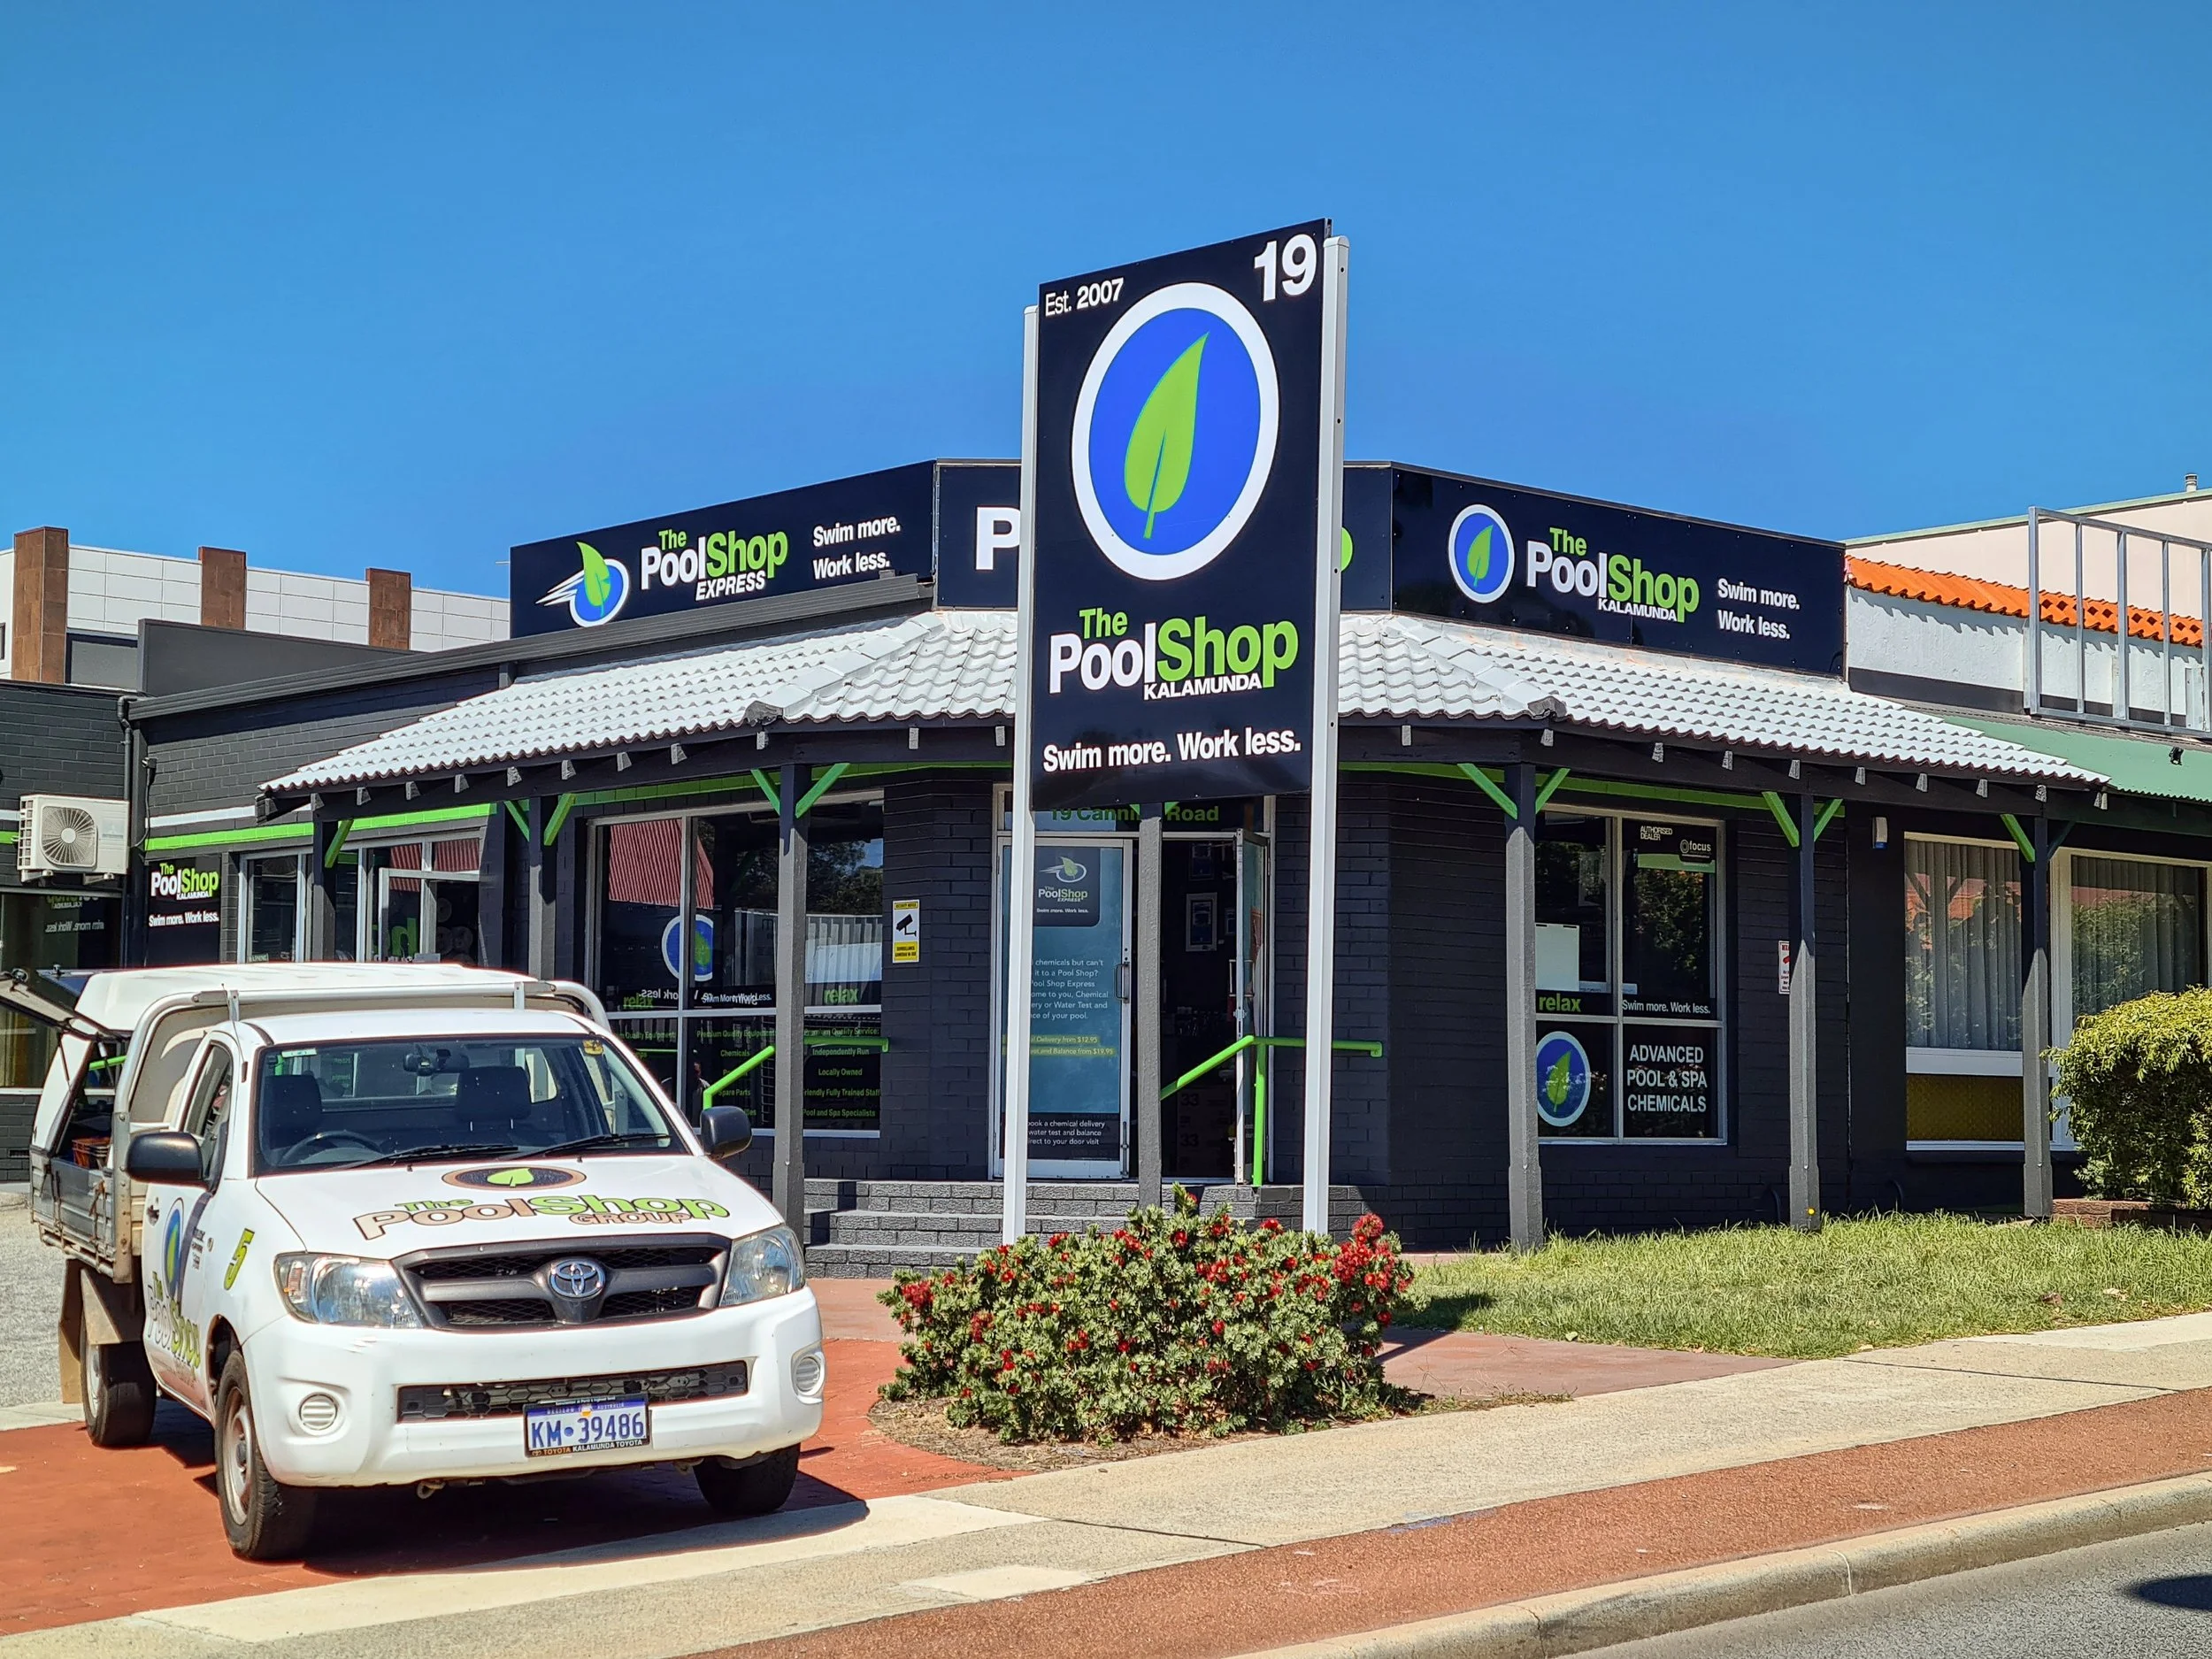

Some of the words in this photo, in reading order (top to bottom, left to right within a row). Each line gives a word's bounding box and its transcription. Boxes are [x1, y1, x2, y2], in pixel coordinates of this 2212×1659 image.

[1255, 234, 1317, 302] 19
[1045, 292, 1072, 317] Est.
[1078, 277, 1124, 310] 2007
[658, 529, 687, 550] The
[813, 520, 854, 547] Swim
[856, 515, 901, 538] more.
[1549, 527, 1587, 557] The
[641, 529, 787, 591] PoolShop
[813, 556, 852, 579] Work
[855, 550, 890, 572] less.
[695, 570, 765, 602] EXPRESS
[1527, 540, 1699, 623] PoolShop
[1718, 578, 1757, 603] Swim
[1759, 588, 1800, 611] more.
[1598, 597, 1678, 622] KALAMUNDA
[1079, 607, 1128, 639] The
[1718, 609, 1755, 635] Work
[1759, 617, 1791, 641] less.
[1049, 616, 1299, 695] PoolShop
[1143, 673, 1263, 701] KALAMUNDA
[1043, 742, 1101, 772] Swim
[1108, 740, 1171, 766] more.
[1177, 729, 1239, 761] Work
[1246, 727, 1301, 754] less.
[1167, 805, 1219, 821] Road
[1640, 826, 1672, 835] AUTHORISED
[1689, 841, 1711, 852] focus
[159, 862, 174, 875] The
[150, 868, 219, 897] PoolShop
[177, 890, 210, 901] KALAMUNDA
[149, 914, 165, 927] Swim
[166, 914, 184, 926] more.
[184, 911, 202, 924] Work
[204, 910, 219, 922] less.
[1076, 970, 1099, 979] Shop?
[1067, 980, 1095, 989] Express
[824, 985, 858, 1004] relax
[1539, 994, 1582, 1012] relax
[1070, 1012, 1088, 1021] pool.
[1623, 1000, 1645, 1012] Swim
[1646, 1002, 1669, 1012] more.
[1671, 1002, 1691, 1014] Work
[1692, 1003, 1710, 1014] less.
[697, 1030, 722, 1039] Premium
[722, 1030, 743, 1039] Quality
[832, 1028, 853, 1037] Quality
[812, 1048, 856, 1056] Independently
[1630, 1044, 1703, 1063] ADVANCED
[818, 1069, 841, 1078] Locally
[1626, 1070, 1662, 1087] POOL
[1669, 1071, 1678, 1088] &
[1681, 1071, 1708, 1088] SPA
[804, 1088, 825, 1097] riendly
[826, 1088, 841, 1097] Fully
[1627, 1094, 1707, 1113] CHEMICALS
[828, 1110, 841, 1118] Spa
[1079, 1120, 1105, 1129] delivery
[395, 1198, 474, 1212] The
[352, 1194, 732, 1240] PoolShop
[568, 1212, 693, 1225] GROUP
[224, 1226, 256, 1292] 5
[577, 1412, 644, 1444] 39486
[543, 1448, 572, 1456] TOYOTA
[572, 1442, 615, 1455] KALAMUNDA
[616, 1439, 642, 1448] TOYOTA
